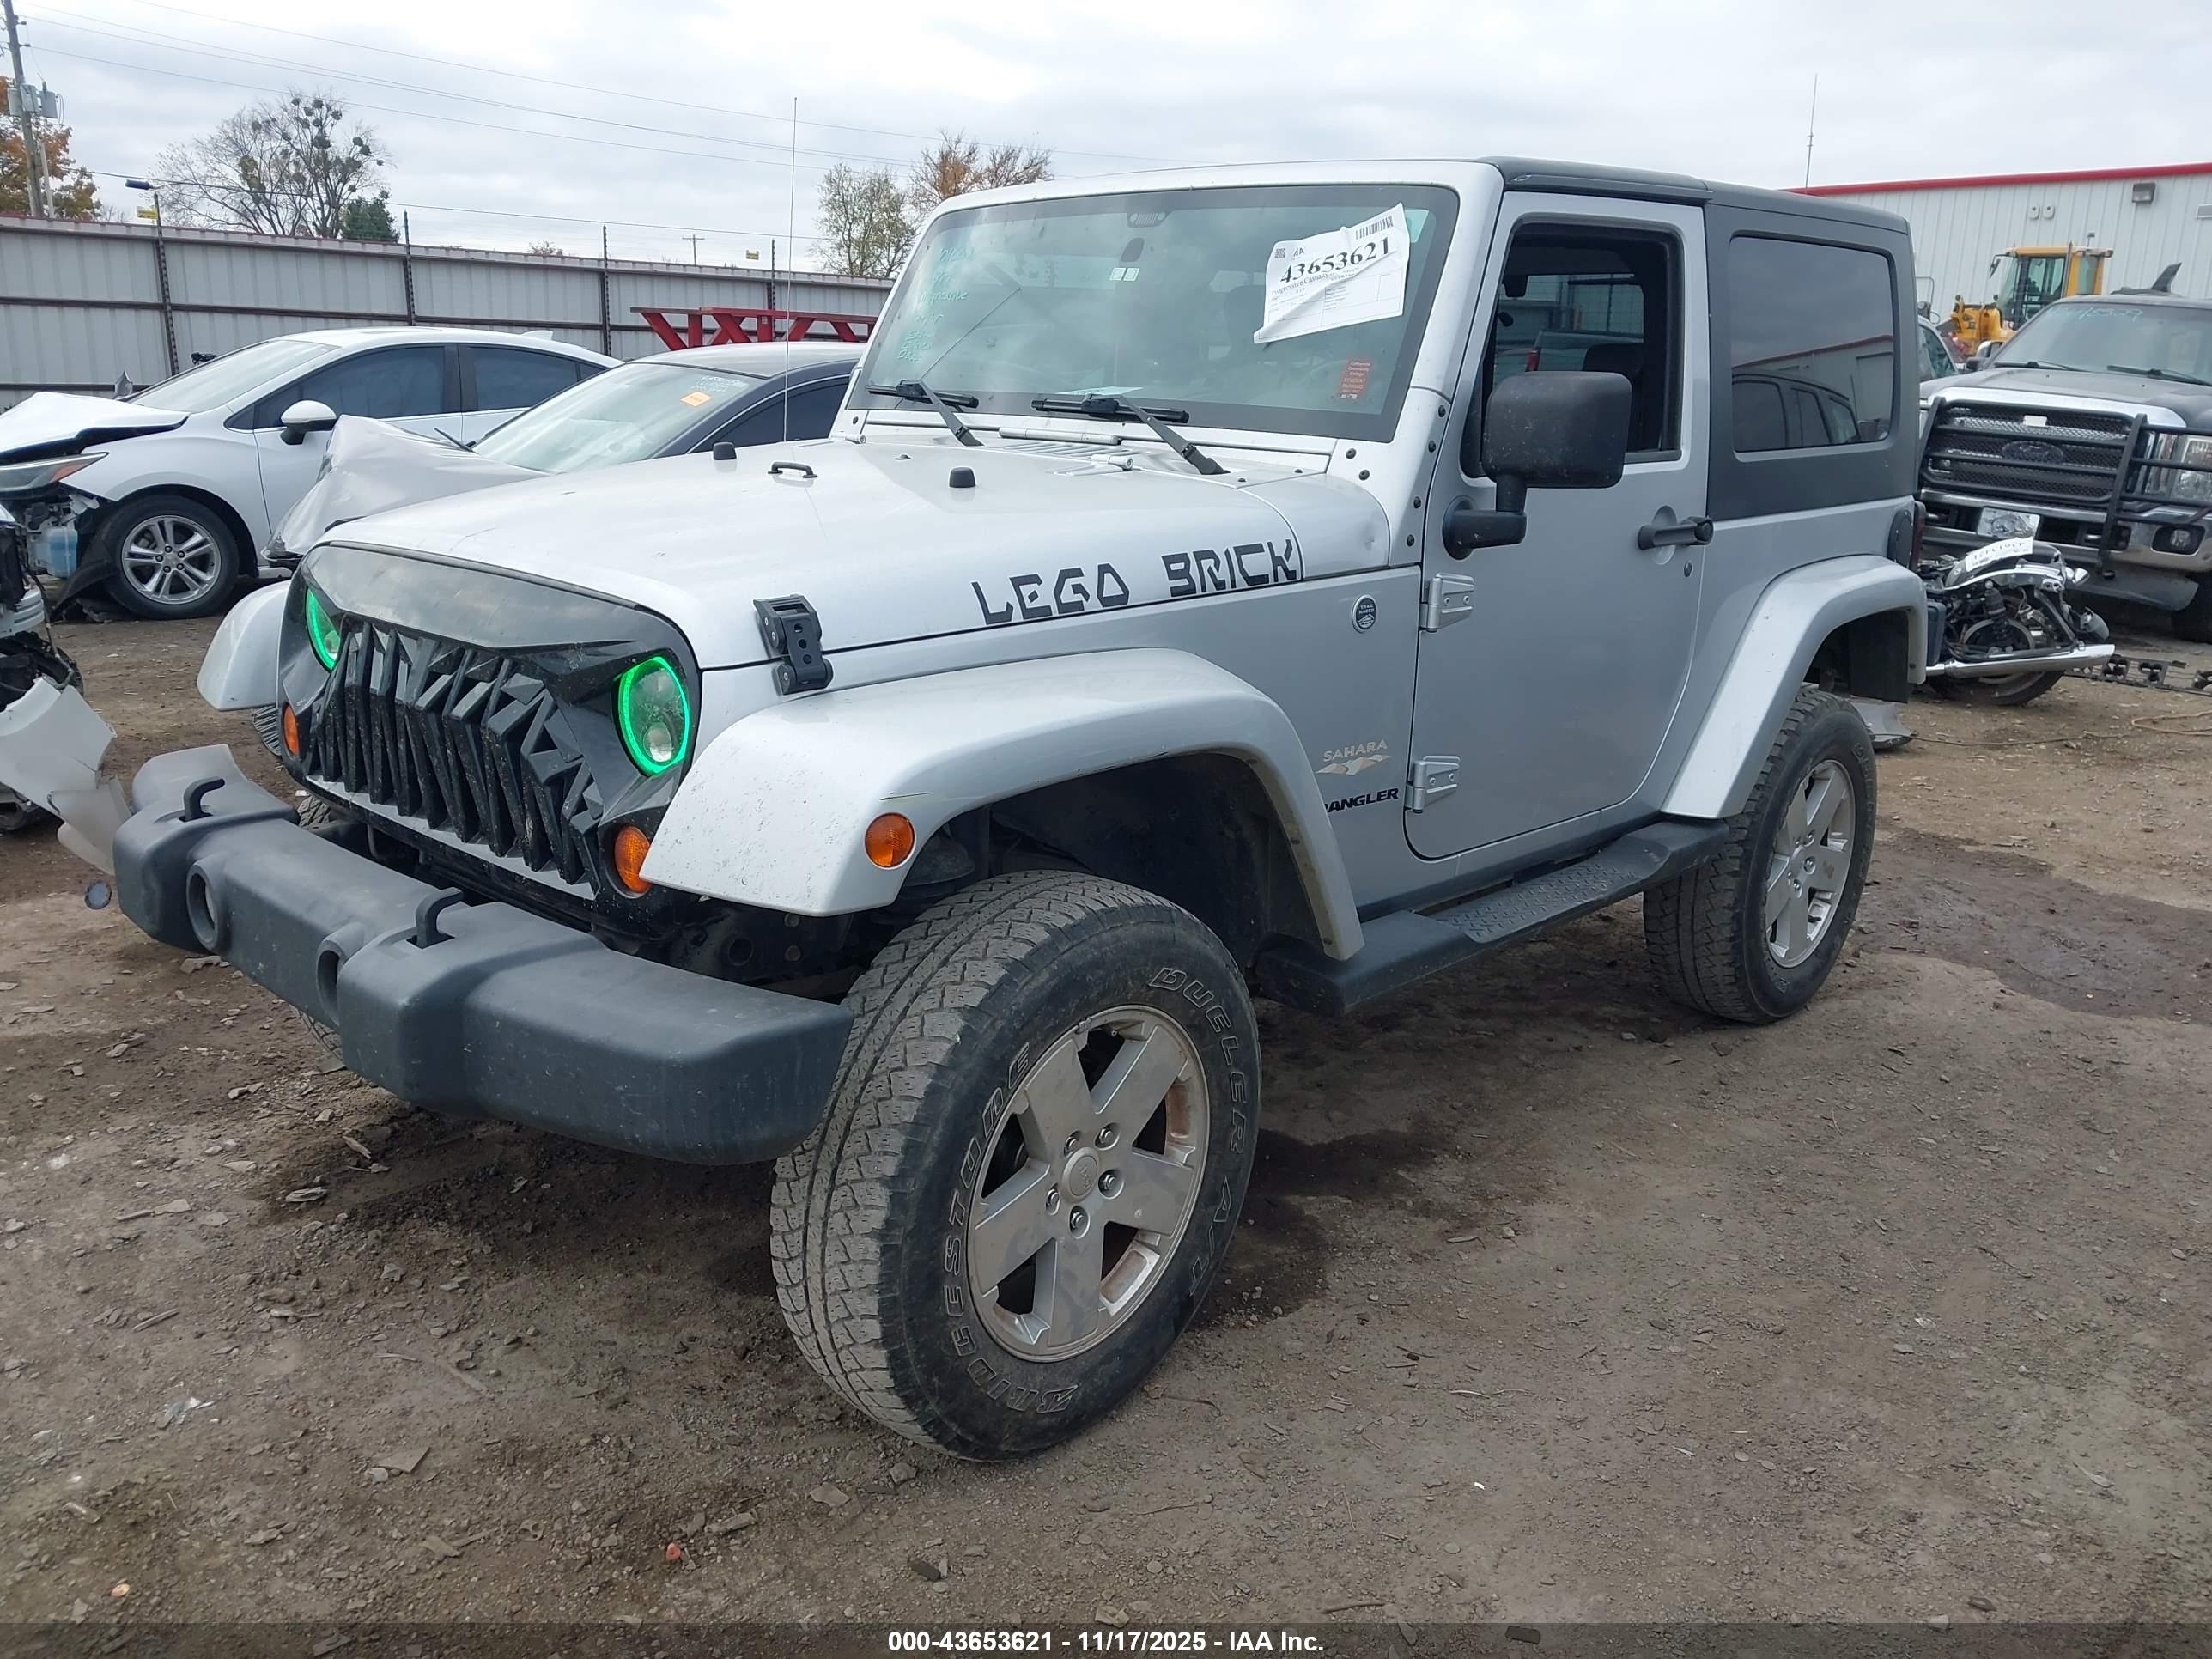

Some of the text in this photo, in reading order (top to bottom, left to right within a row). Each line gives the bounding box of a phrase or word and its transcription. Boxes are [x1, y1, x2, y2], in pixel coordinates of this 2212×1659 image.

[1279, 236, 1389, 283] 43653621
[971, 538, 1297, 626] LEGO BRICK
[1322, 738, 1388, 762] SAHARA
[1148, 967, 1249, 1155] DUELER
[944, 1042, 1079, 1414] BRIDGESTONE
